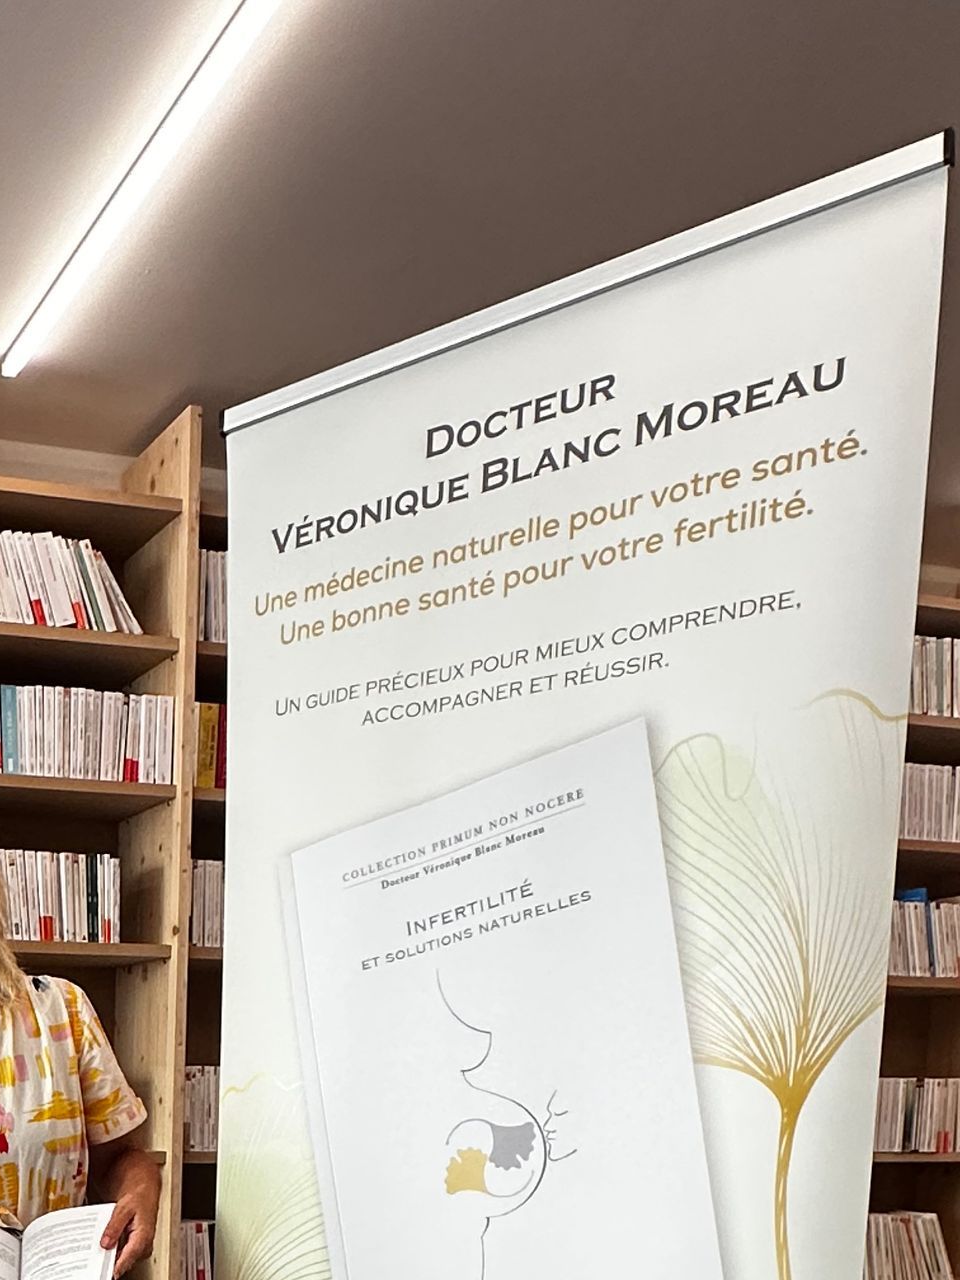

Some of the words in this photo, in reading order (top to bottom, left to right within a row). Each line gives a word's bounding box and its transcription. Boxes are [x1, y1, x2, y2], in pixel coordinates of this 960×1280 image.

[255, 591, 297, 616] Une
[304, 555, 424, 603] médecine
[432, 515, 560, 569] naturelle
[568, 494, 644, 540] pour
[650, 468, 741, 508] votre
[751, 429, 868, 482] santé.
[281, 620, 325, 645] Une
[331, 598, 410, 632] bonne
[418, 570, 495, 611] santé
[503, 556, 574, 598] pour
[580, 533, 664, 570] votre
[673, 489, 814, 547] fertilité.
[276, 698, 300, 716] UN
[306, 684, 360, 709] GUIDE
[366, 663, 464, 696] PRÉCIEUX
[471, 649, 529, 676] POUR
[536, 633, 604, 662] MIEUX
[611, 590, 801, 645] COMPRENDRE,
[362, 681, 522, 726] ACCOMPAGNER
[530, 673, 558, 694] ET
[564, 652, 669, 688] RÉUSSIR.
[342, 846, 426, 882] COLLECTION
[432, 825, 485, 853] PRIMUM
[489, 811, 519, 831] NON
[524, 788, 585, 817] NOCERE
[380, 872, 420, 890] Docteur
[422, 852, 473, 875] Véronique
[474, 842, 502, 857] Blanc
[505, 826, 545, 846] Moreau
[361, 956, 382, 971] ET
[385, 928, 474, 964] SOLUTIONS
[479, 891, 591, 935] NATURELLES
[406, 878, 534, 936] INFERTILITÉ
